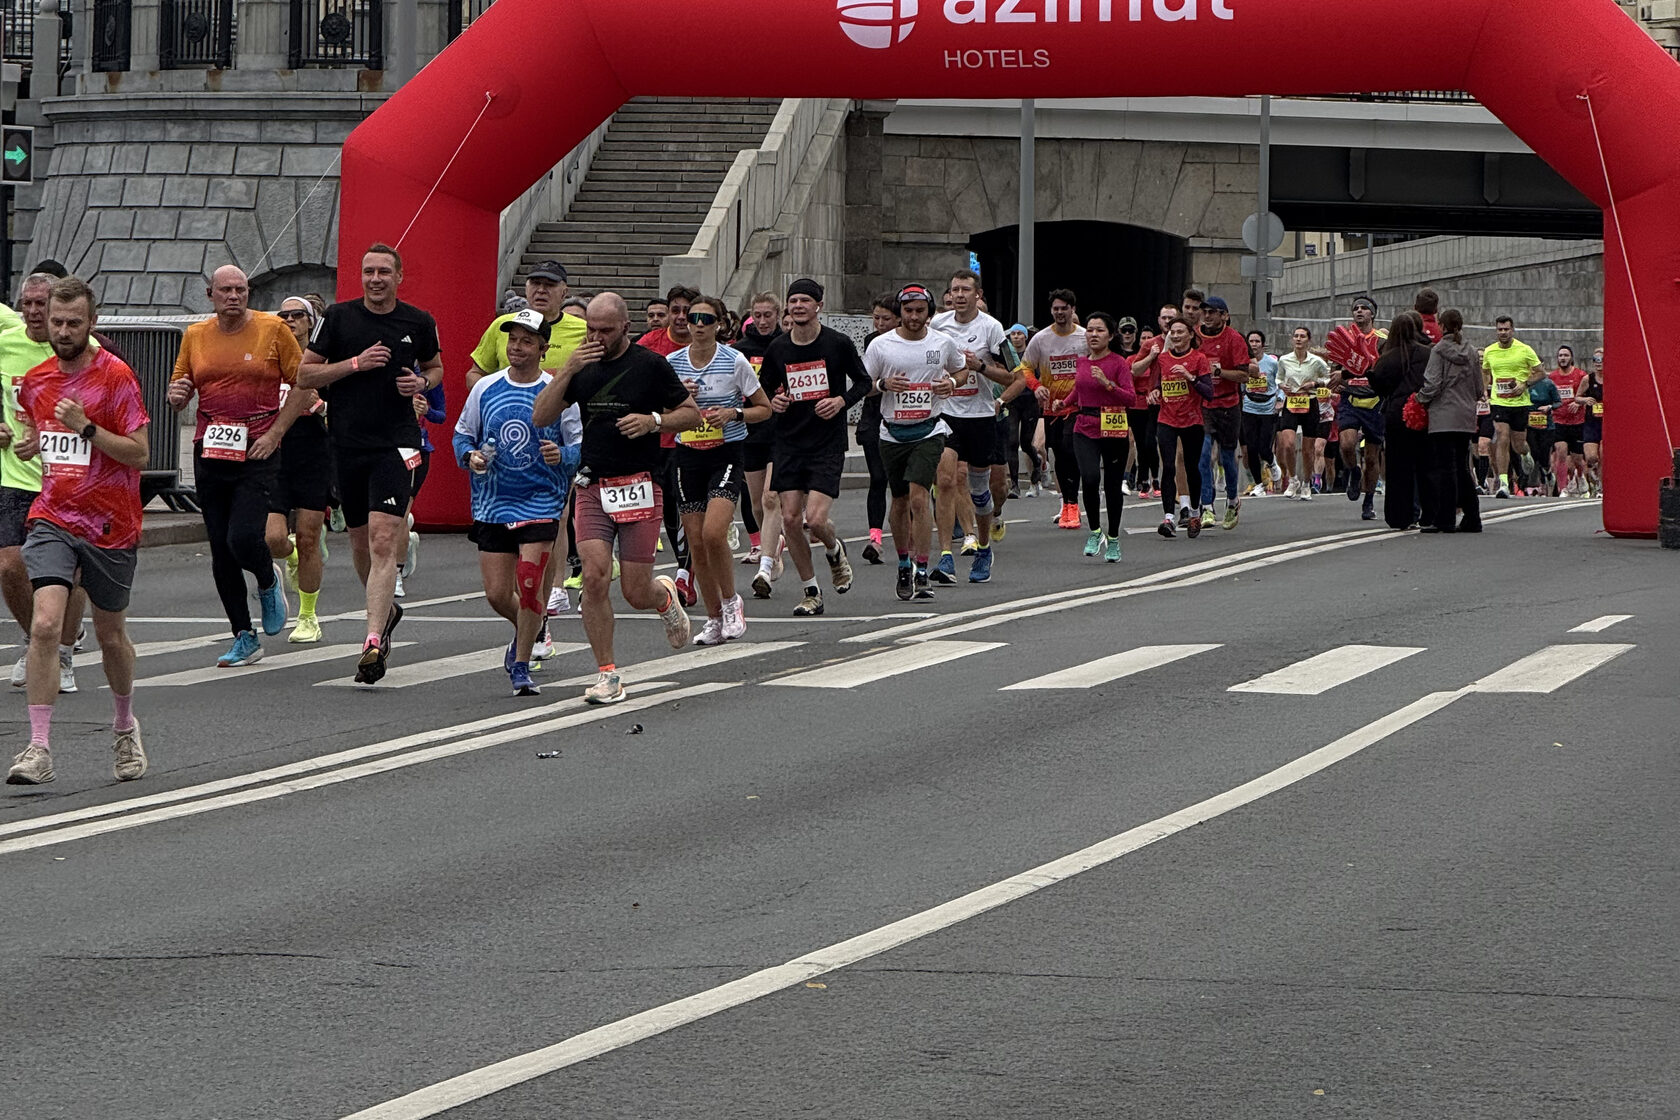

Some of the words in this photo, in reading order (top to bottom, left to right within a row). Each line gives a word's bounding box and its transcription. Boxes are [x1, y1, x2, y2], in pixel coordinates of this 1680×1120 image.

[944, 49, 1050, 68] HOTELS
[789, 373, 827, 388] 26312
[1162, 381, 1187, 391] 20978
[895, 392, 930, 404] 12562
[208, 427, 241, 442] 3296
[41, 435, 88, 455] 21011
[608, 485, 646, 503] 3161
